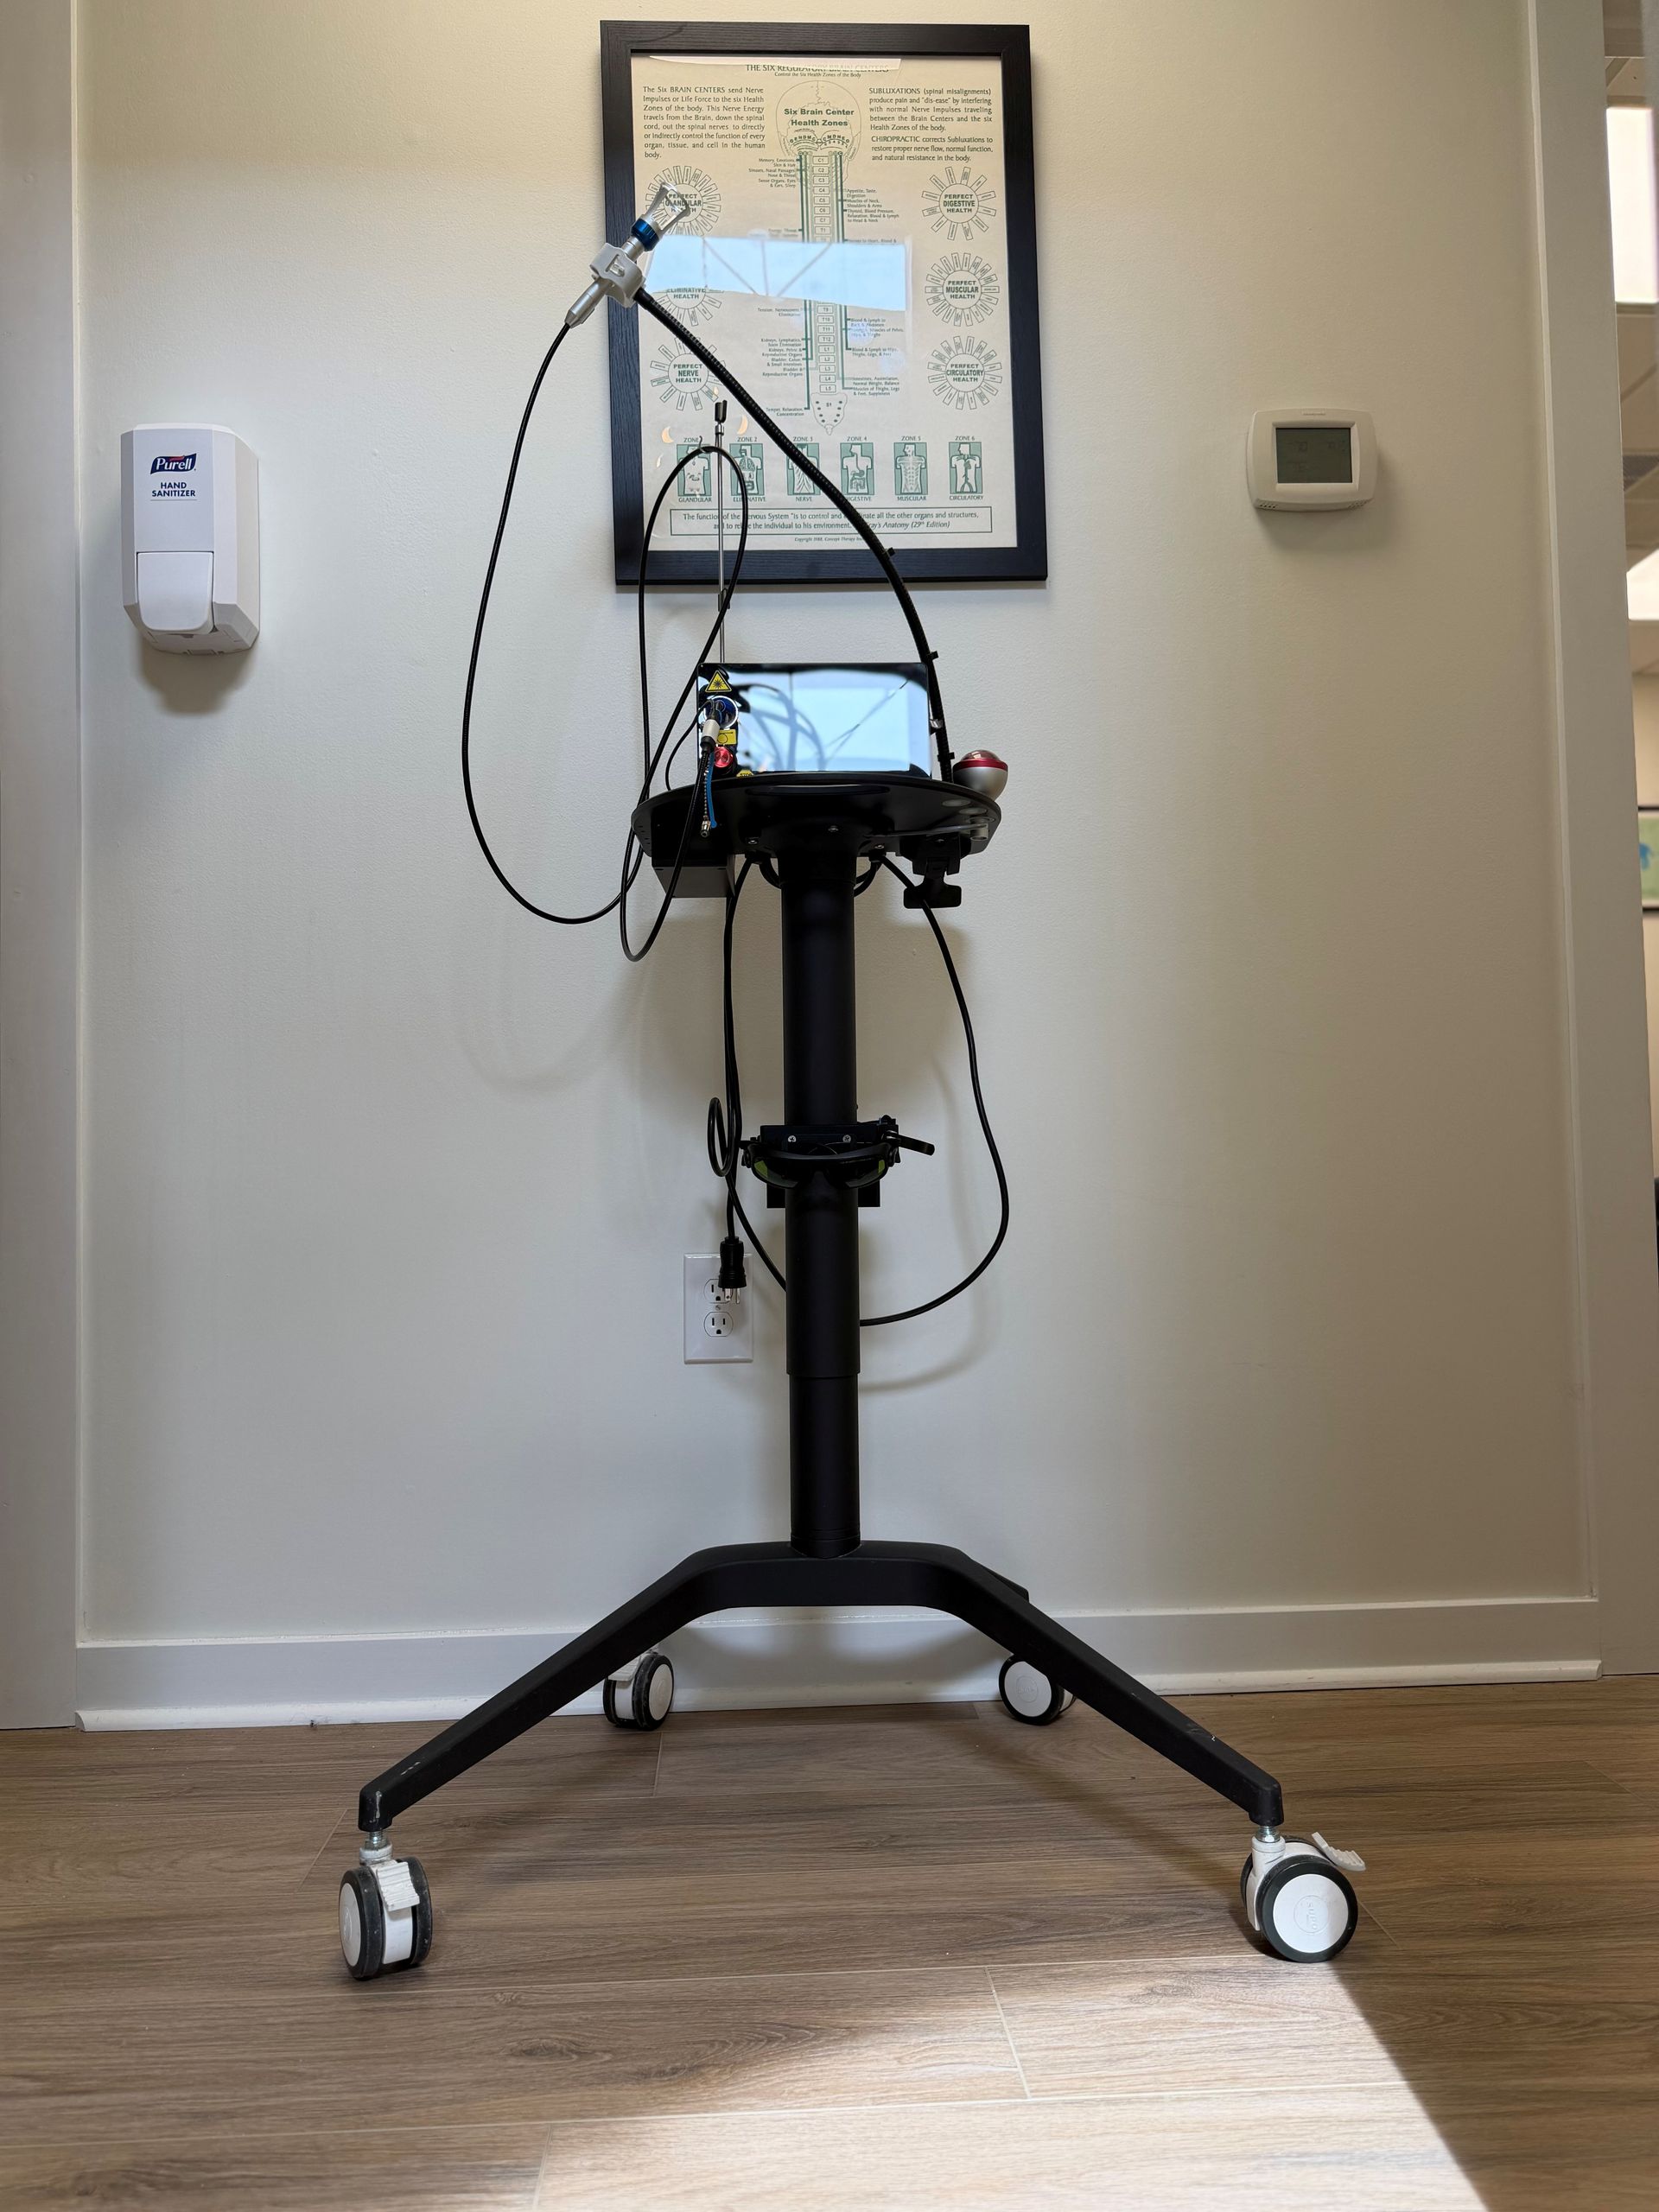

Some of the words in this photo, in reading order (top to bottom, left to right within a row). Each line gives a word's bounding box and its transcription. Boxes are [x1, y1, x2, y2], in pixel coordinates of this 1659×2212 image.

[643, 95, 671, 104] Impulses
[645, 151, 661, 160] body.
[156, 458, 192, 470] Purell
